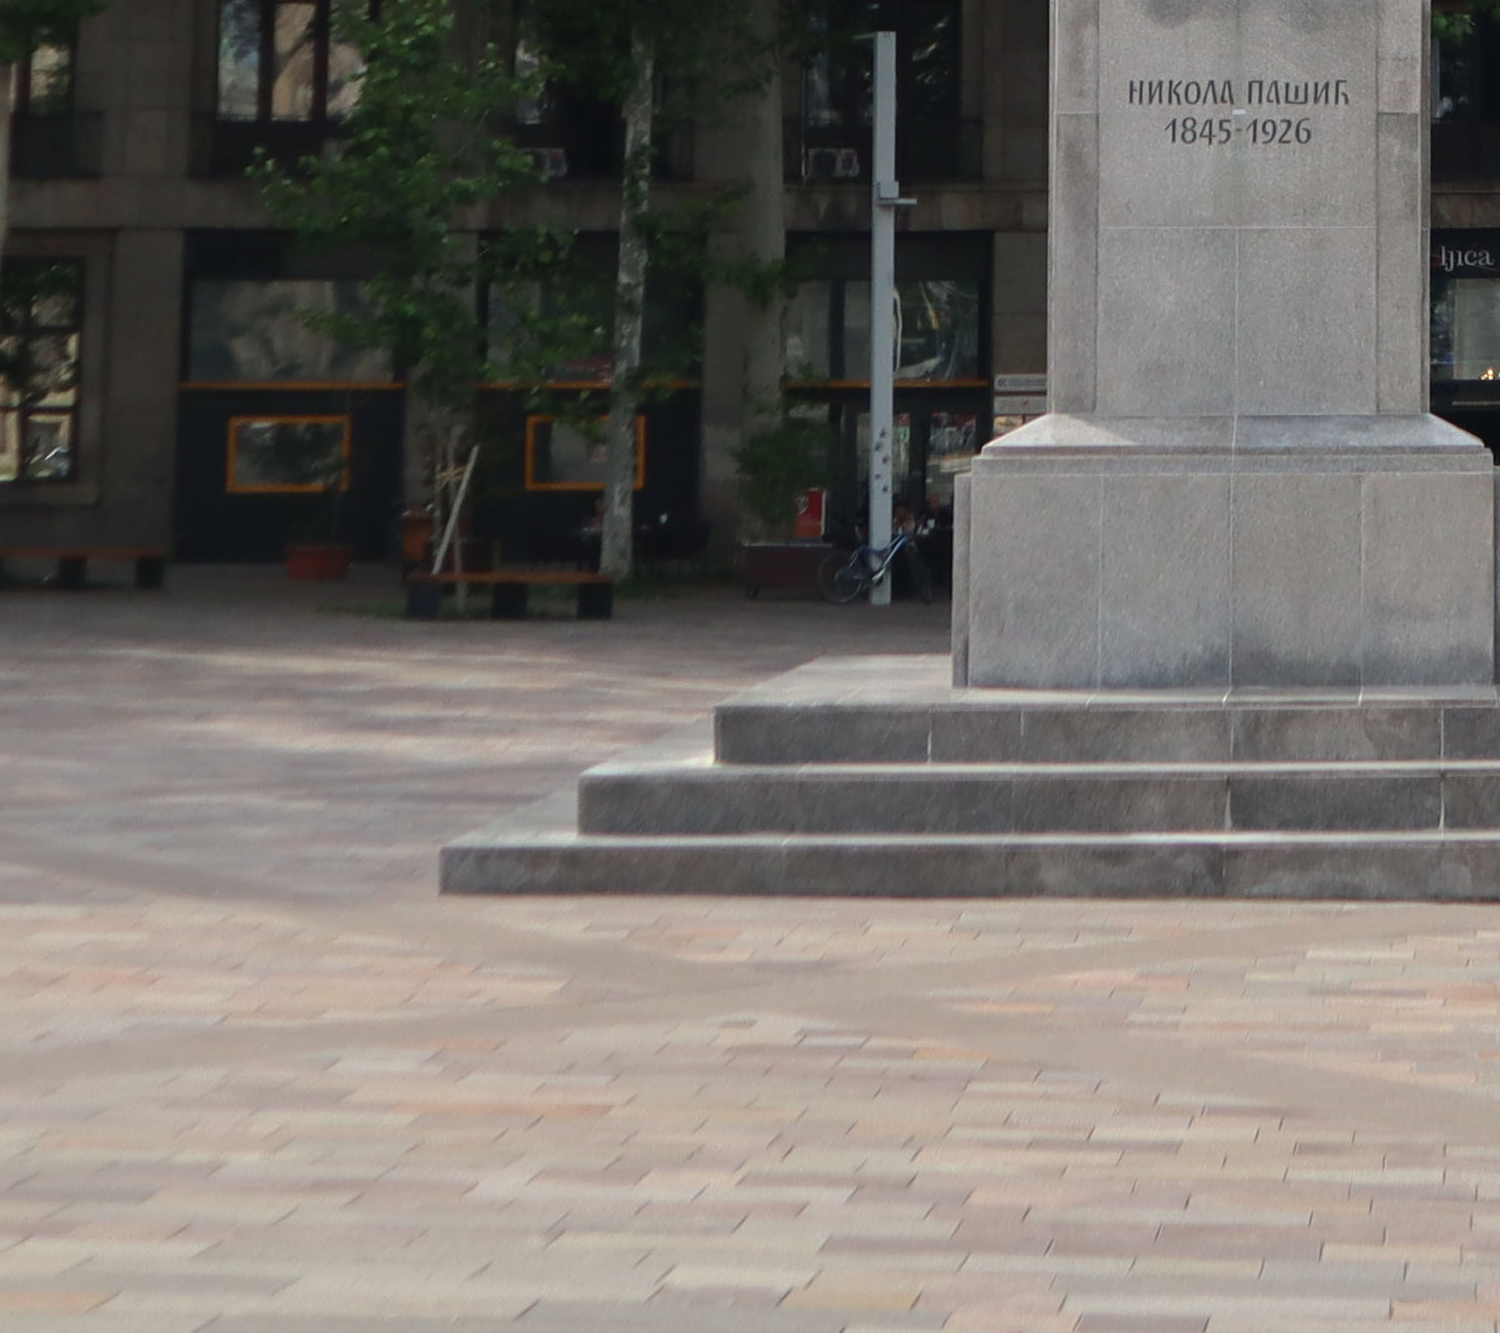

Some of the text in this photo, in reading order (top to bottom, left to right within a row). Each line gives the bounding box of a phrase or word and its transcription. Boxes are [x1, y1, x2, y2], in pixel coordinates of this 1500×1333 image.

[1127, 79, 1351, 107] НИКОЛА ПАШИЋ
[1163, 116, 1313, 146] 1845-1926
